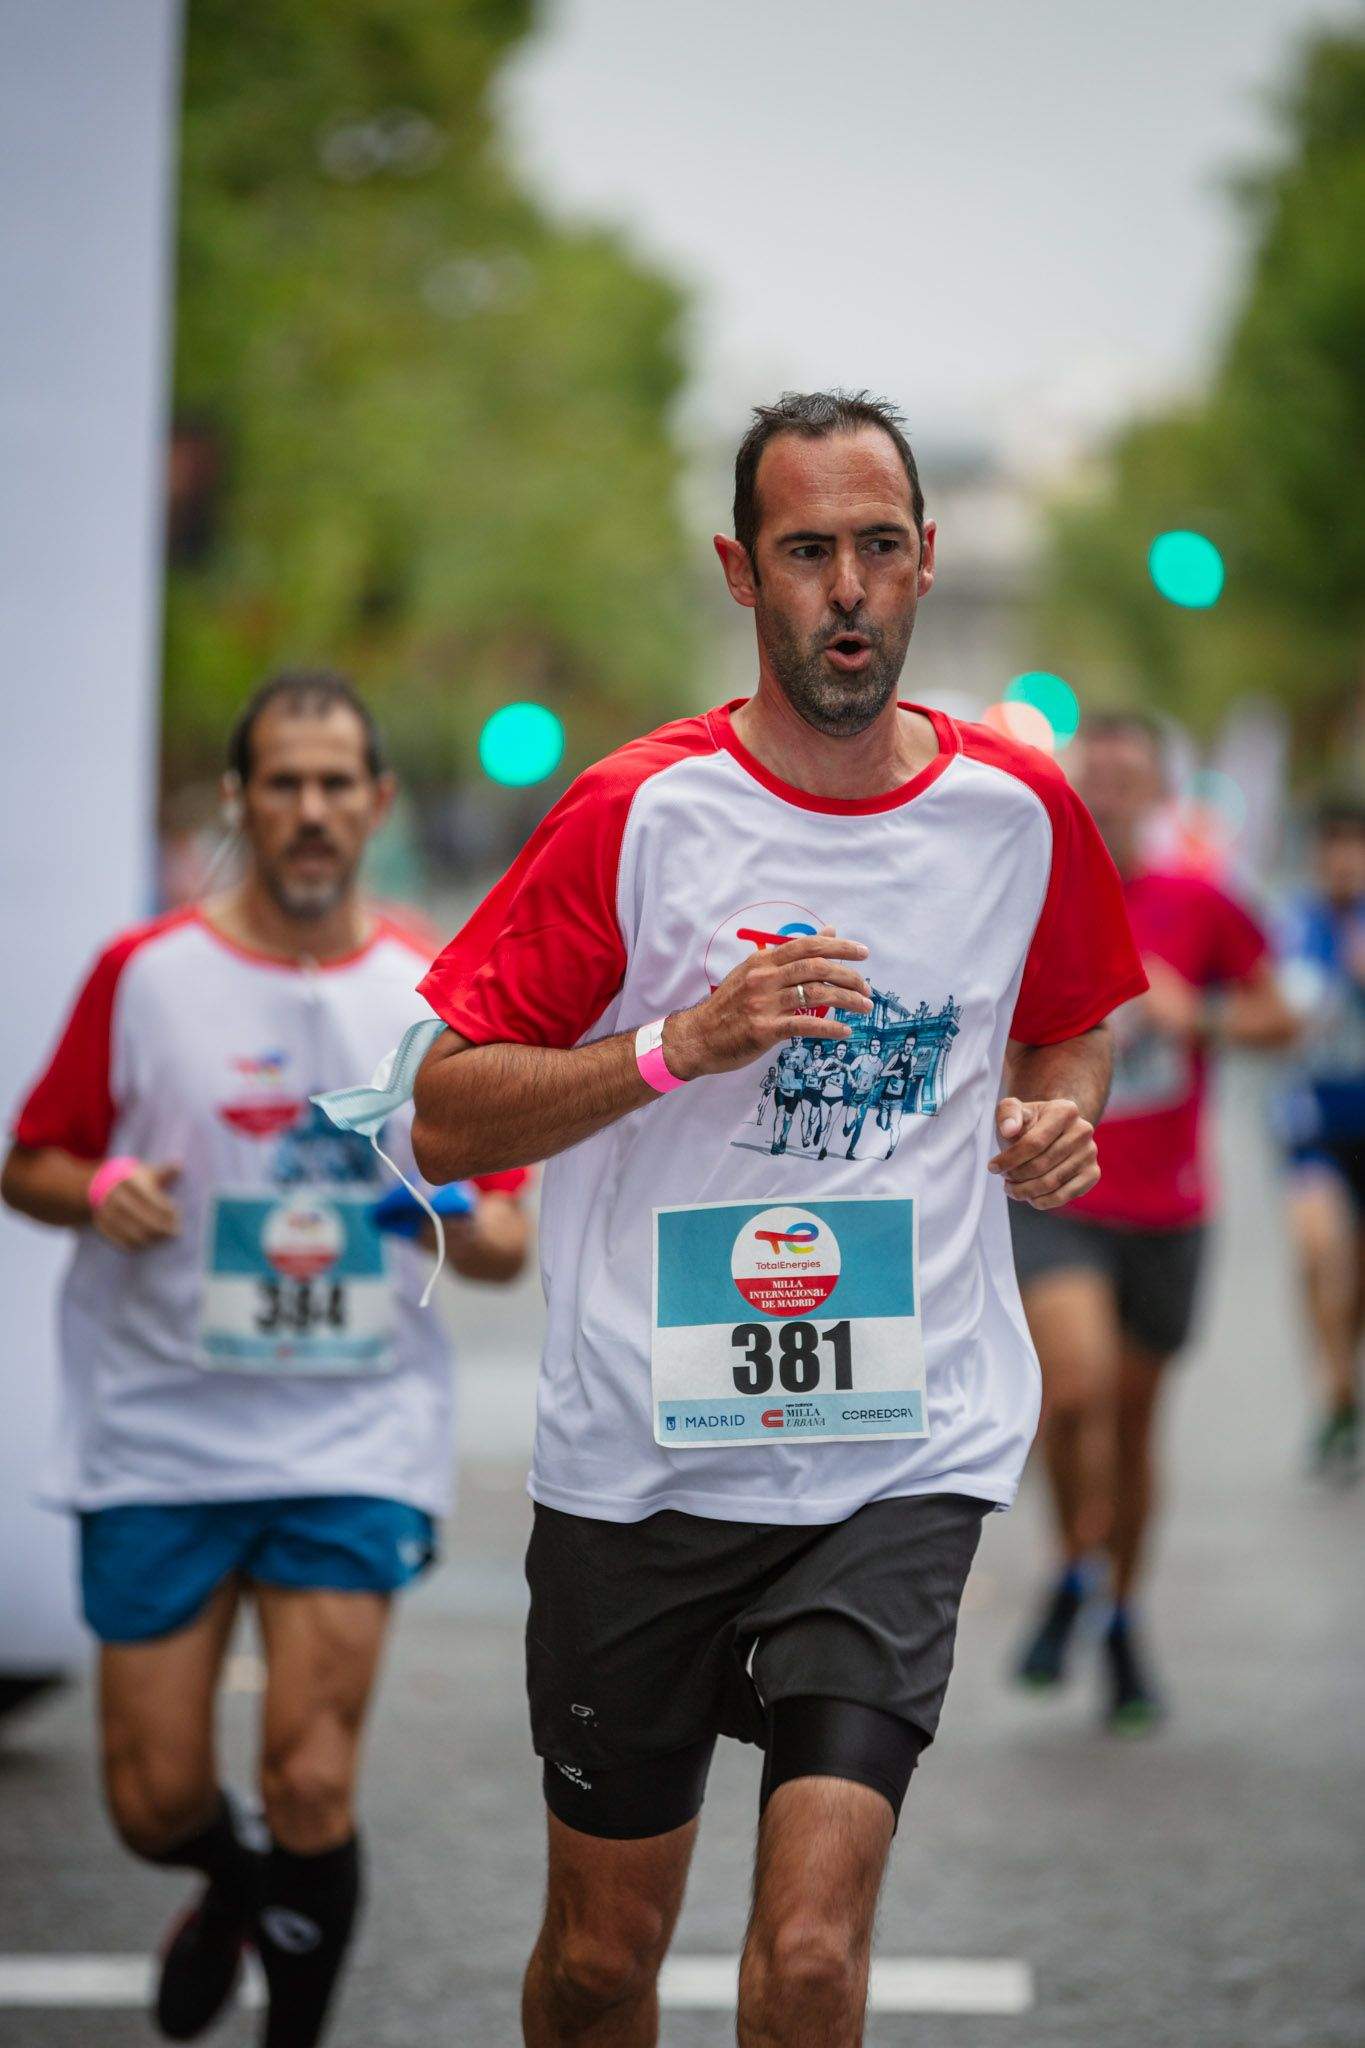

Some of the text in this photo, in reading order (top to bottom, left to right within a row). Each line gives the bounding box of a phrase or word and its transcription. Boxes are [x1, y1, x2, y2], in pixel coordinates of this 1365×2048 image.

[756, 1260, 821, 1270] TotalEnergies
[772, 1280, 803, 1288] MILLA
[777, 1298, 816, 1307] MADRID
[731, 1320, 853, 1395] 381
[786, 1408, 820, 1417] MILLA
[685, 1415, 745, 1428] MADRID
[786, 1417, 826, 1427] URBANA
